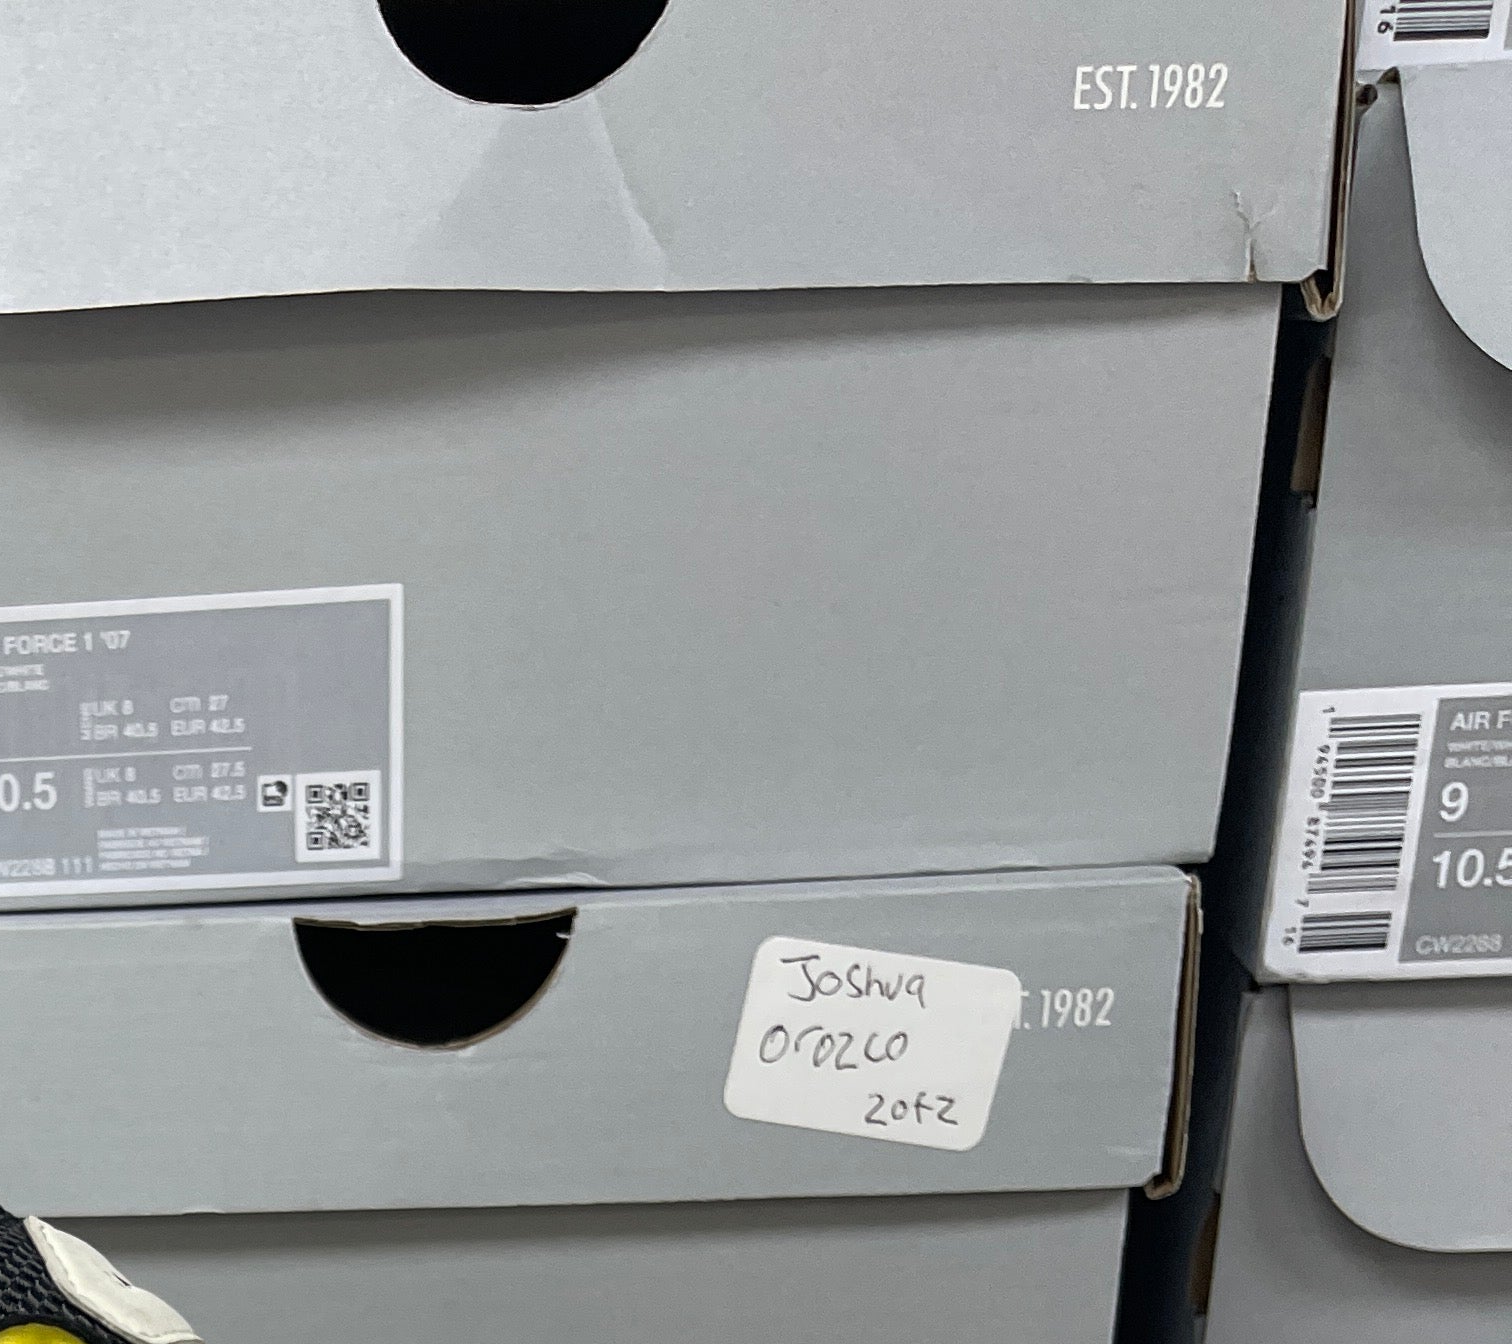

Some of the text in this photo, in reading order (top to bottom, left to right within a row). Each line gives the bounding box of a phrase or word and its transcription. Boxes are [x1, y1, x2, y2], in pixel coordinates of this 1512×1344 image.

[1148, 63, 1229, 109] 1982
[3, 632, 77, 656] FORCE
[83, 632, 93, 651] 1
[1450, 711, 1491, 731] AIR
[1440, 781, 1469, 822] 9
[1040, 987, 1115, 1028] 1982
